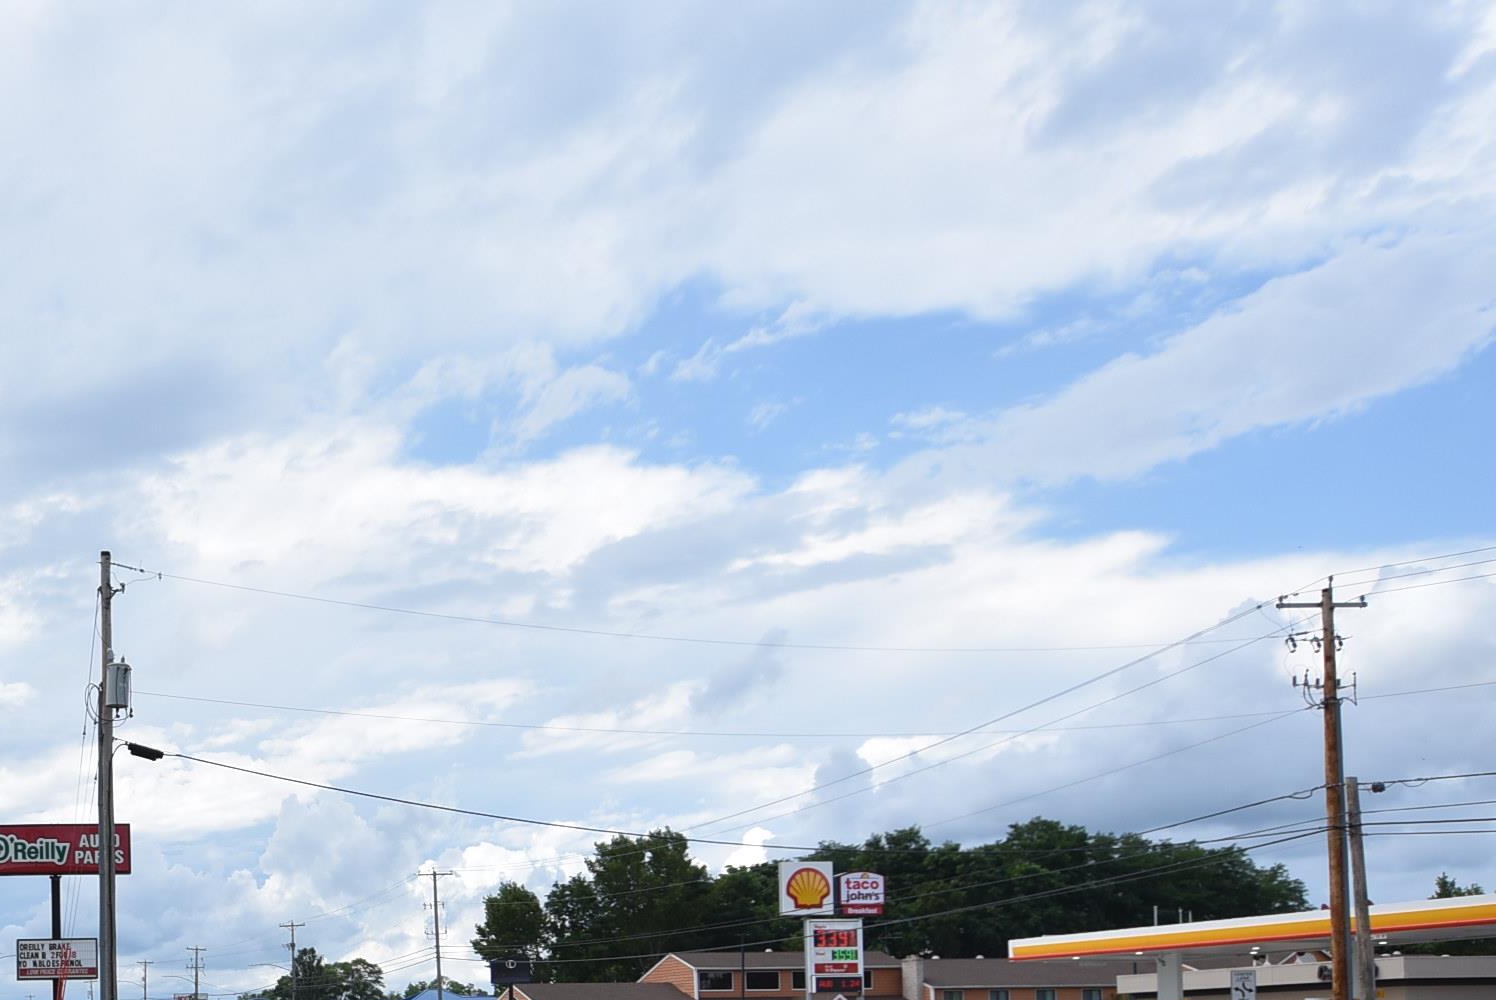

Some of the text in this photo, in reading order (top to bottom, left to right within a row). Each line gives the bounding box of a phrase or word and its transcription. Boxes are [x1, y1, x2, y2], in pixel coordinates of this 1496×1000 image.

[79, 833, 120, 848] AUO
[74, 850, 124, 865] PAS
[845, 878, 879, 890] taco
[846, 890, 881, 902] john's
